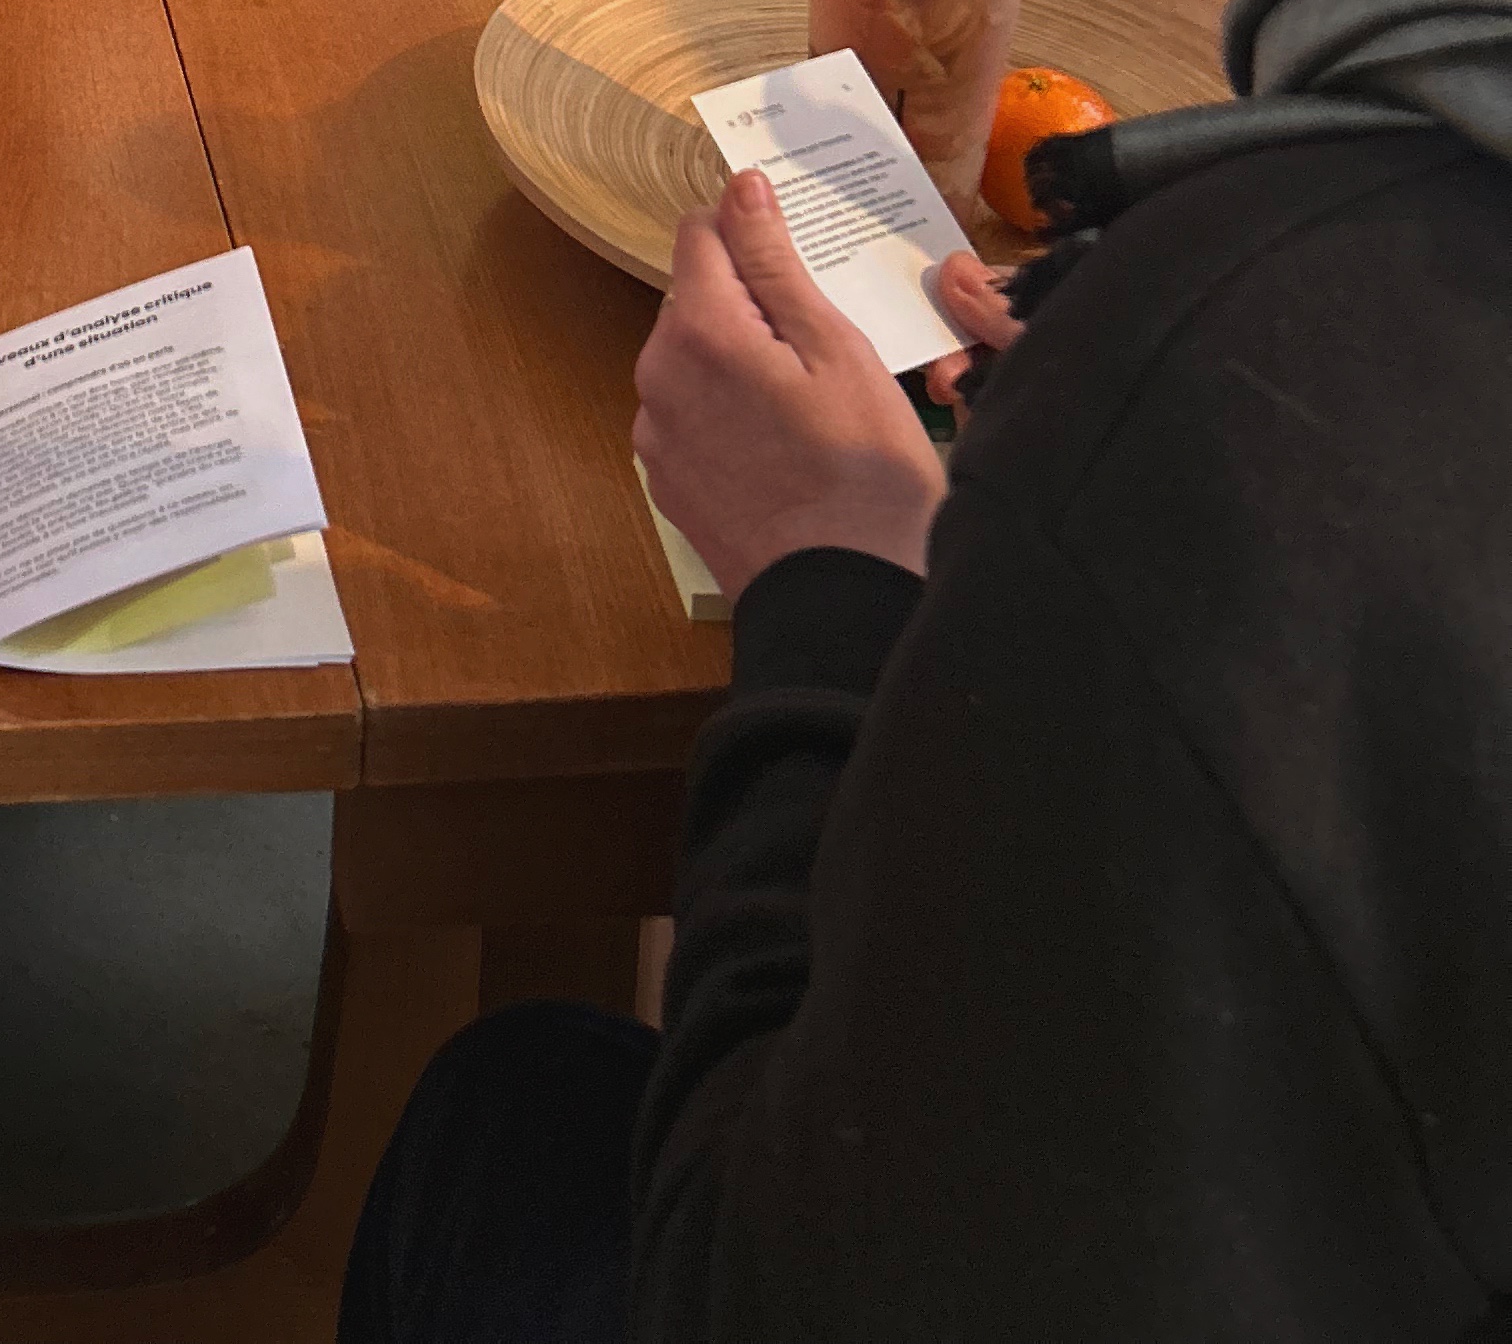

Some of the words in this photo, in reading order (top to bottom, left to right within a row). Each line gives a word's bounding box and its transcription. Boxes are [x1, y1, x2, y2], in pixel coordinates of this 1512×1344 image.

[23, 343, 76, 370] d'une
[78, 313, 159, 349] situation
[53, 305, 141, 344] d'analyse
[144, 281, 213, 312] critique
